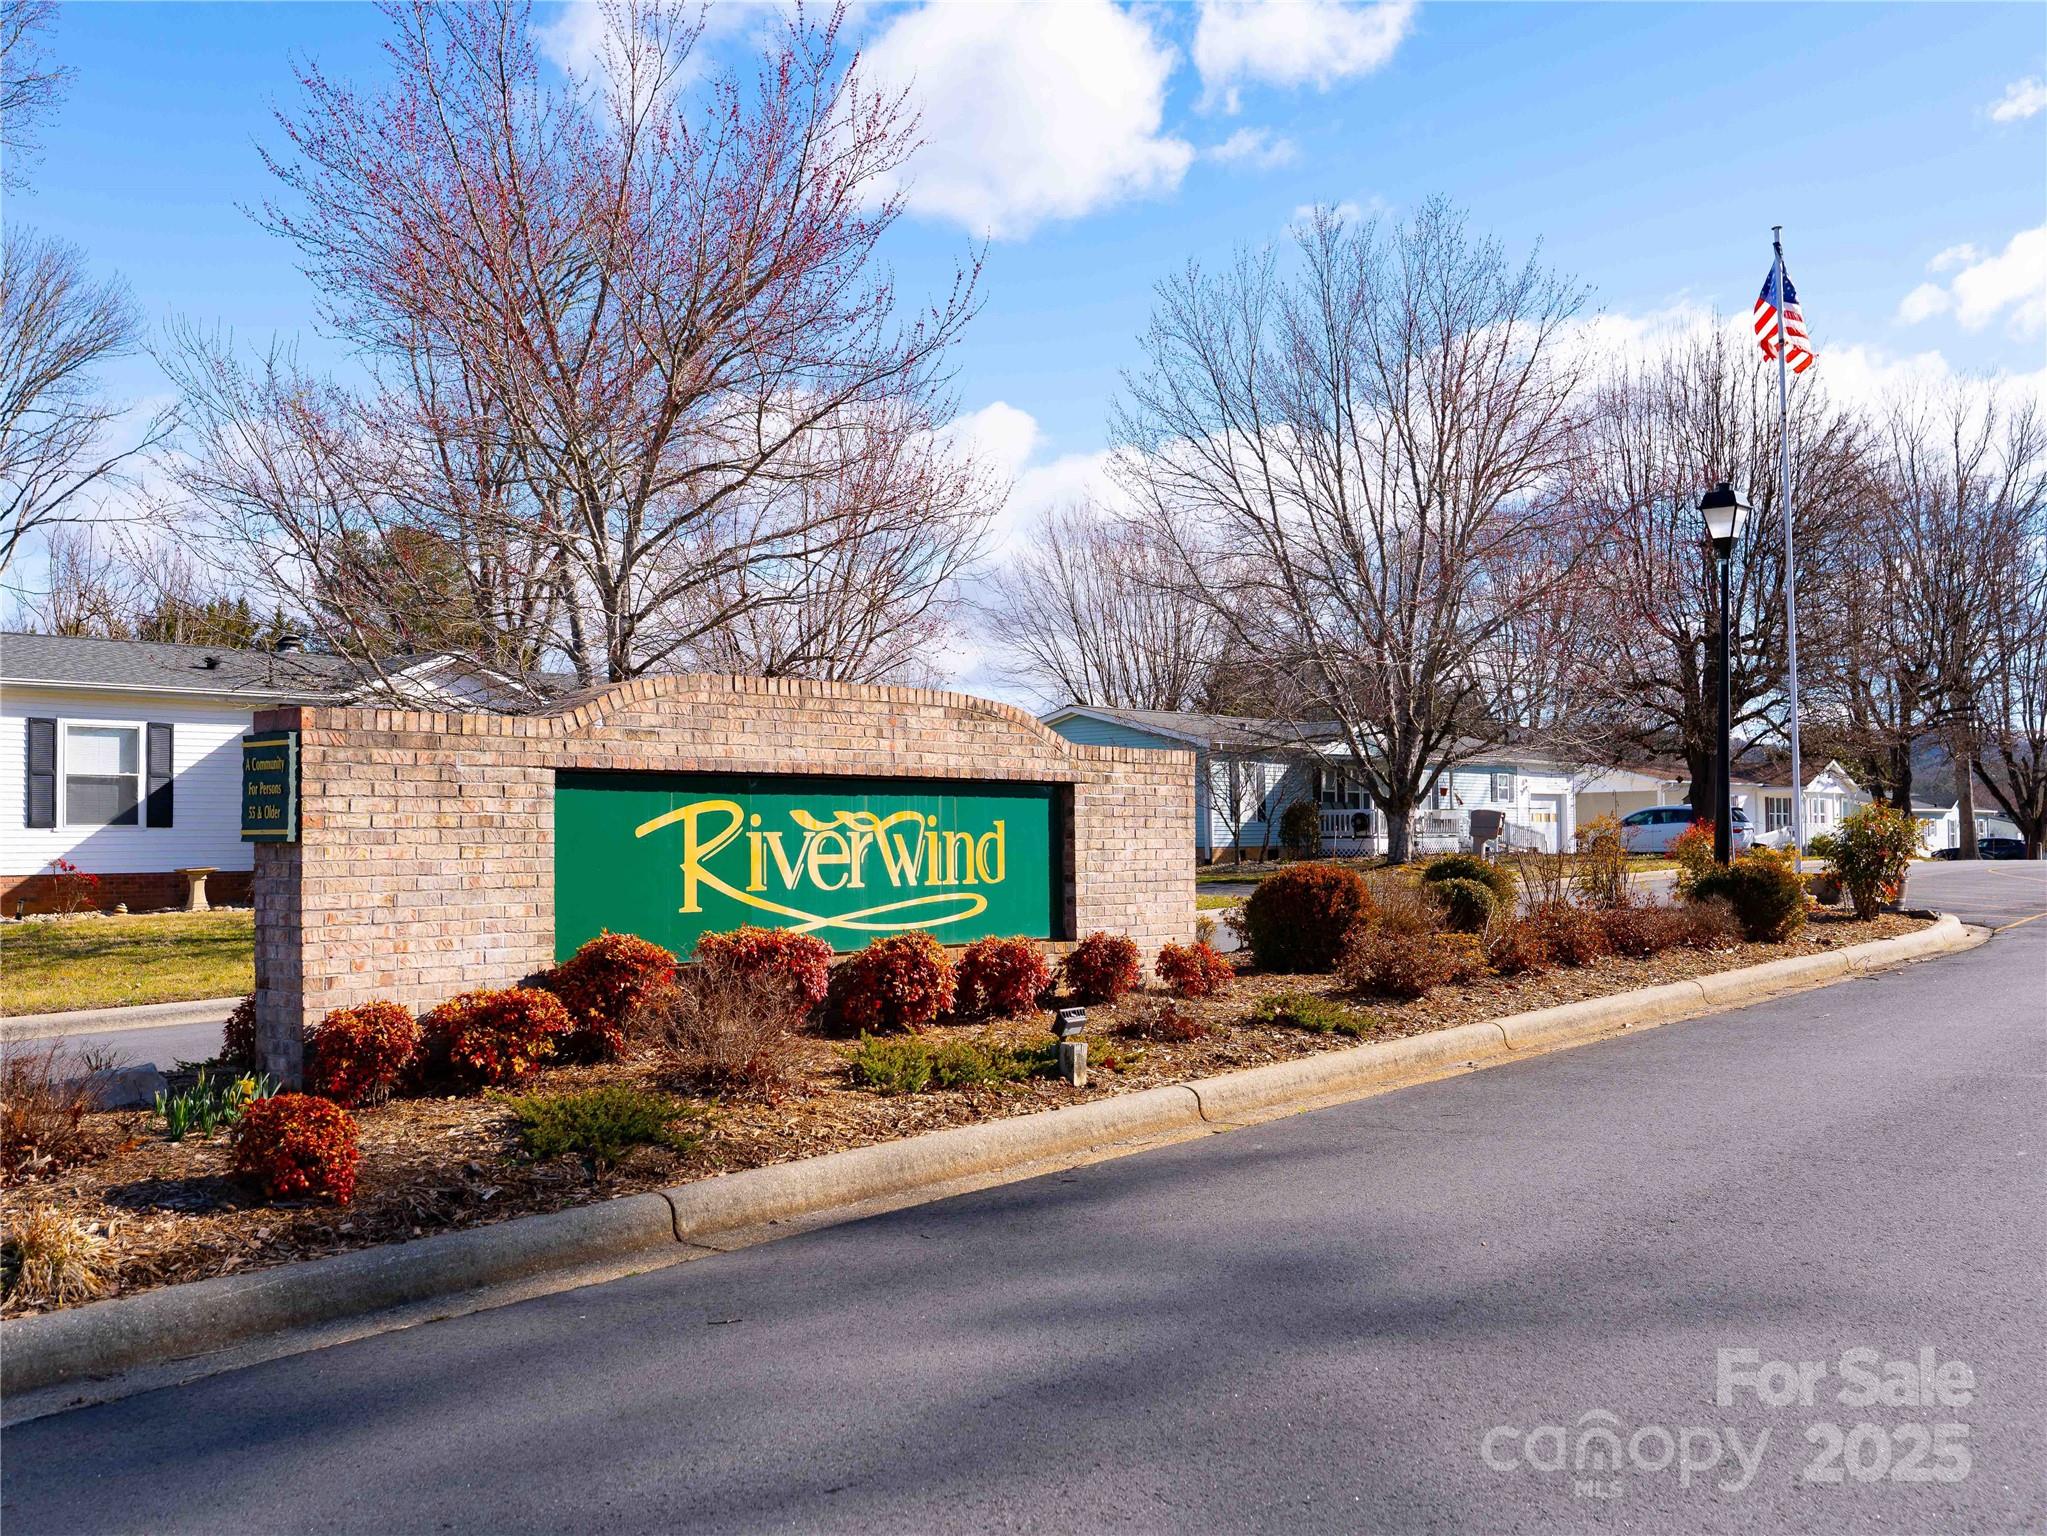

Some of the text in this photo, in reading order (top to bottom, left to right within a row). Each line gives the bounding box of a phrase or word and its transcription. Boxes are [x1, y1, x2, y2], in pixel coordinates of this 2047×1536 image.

[245, 756, 284, 772] A Community
[248, 782, 281, 795] For Persons
[248, 805, 280, 818] 55 & Older
